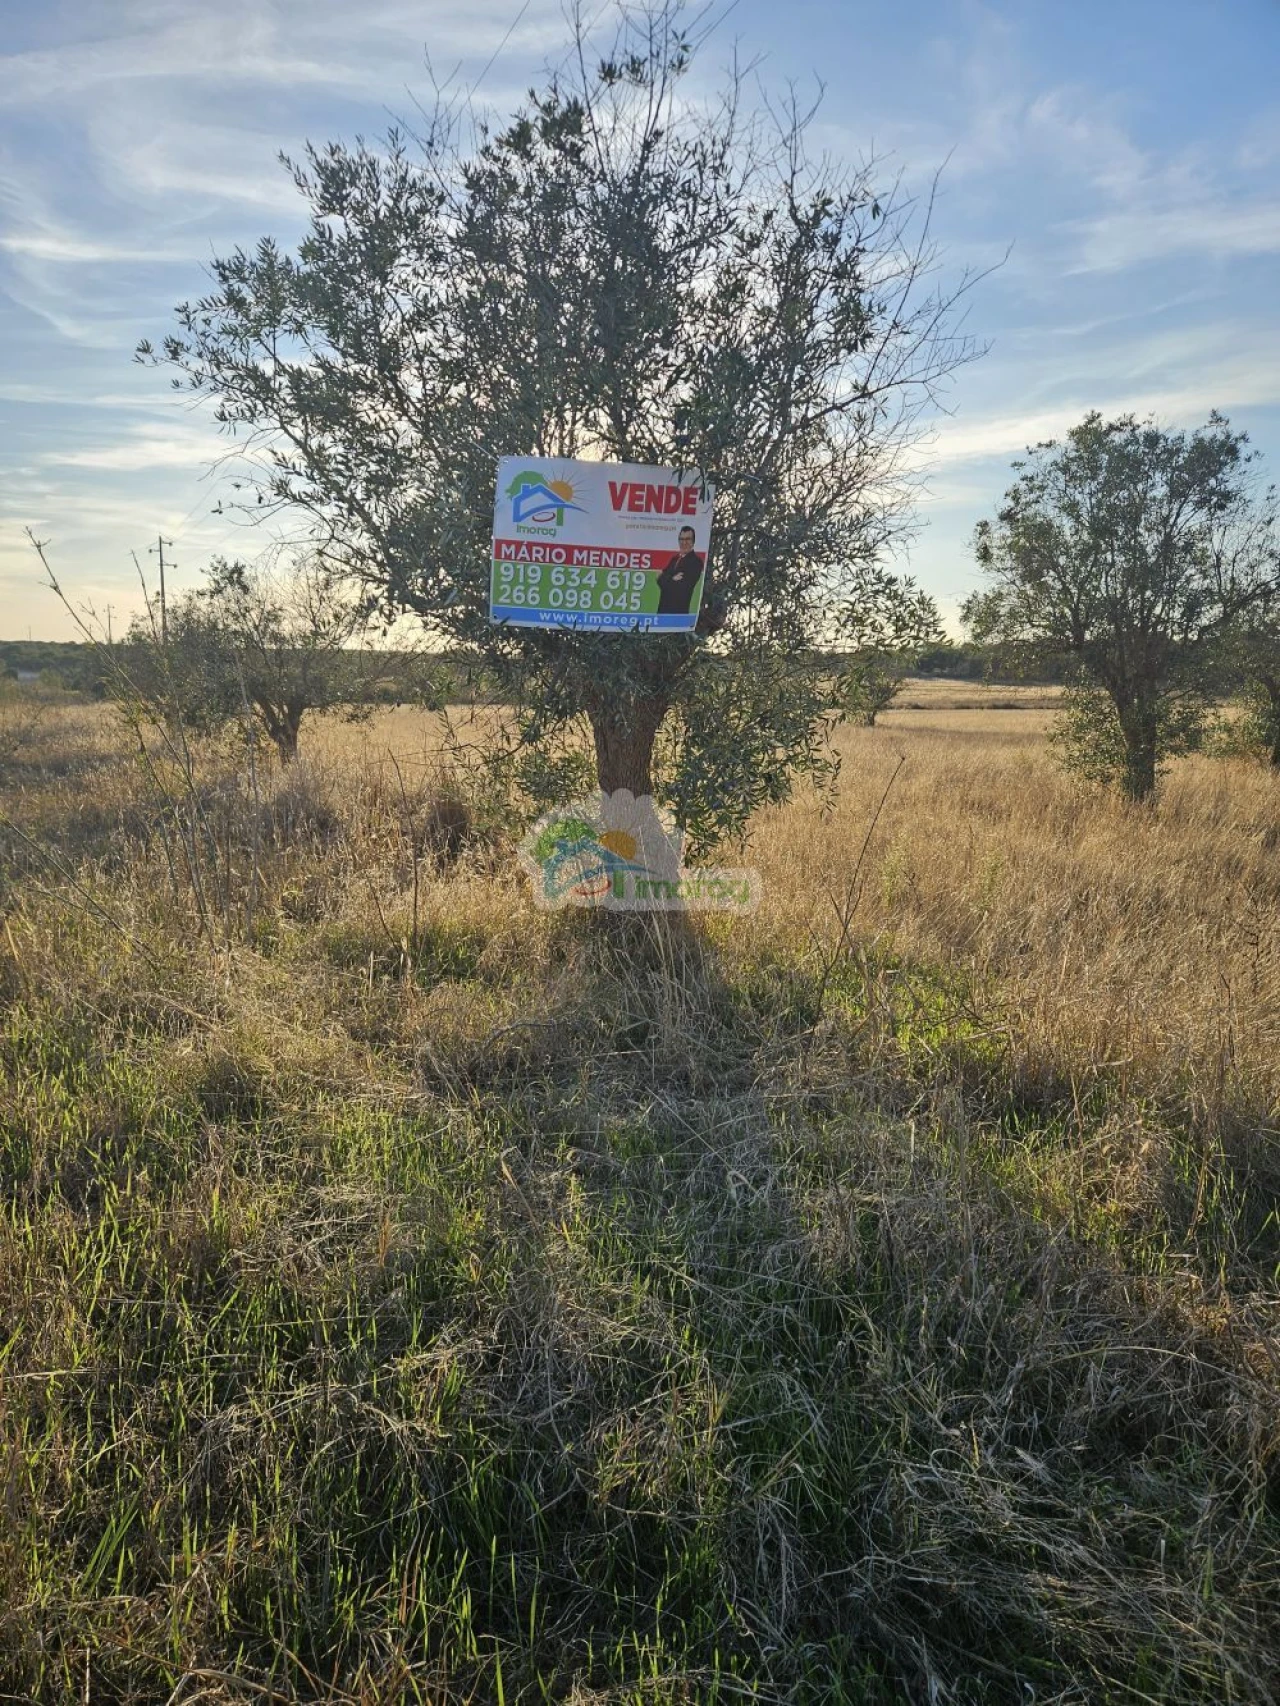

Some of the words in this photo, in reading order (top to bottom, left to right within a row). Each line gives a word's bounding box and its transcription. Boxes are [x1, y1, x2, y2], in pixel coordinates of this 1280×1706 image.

[608, 481, 699, 515] VENDE
[501, 541, 566, 564] MÁRIO
[573, 549, 651, 568] MENDES
[500, 563, 541, 584] 919
[550, 568, 597, 588] 634
[607, 571, 646, 590] 619
[499, 584, 540, 605] 266
[548, 589, 592, 608] 098
[599, 593, 641, 611] 045
[539, 611, 659, 627] www.imoreg.pt
